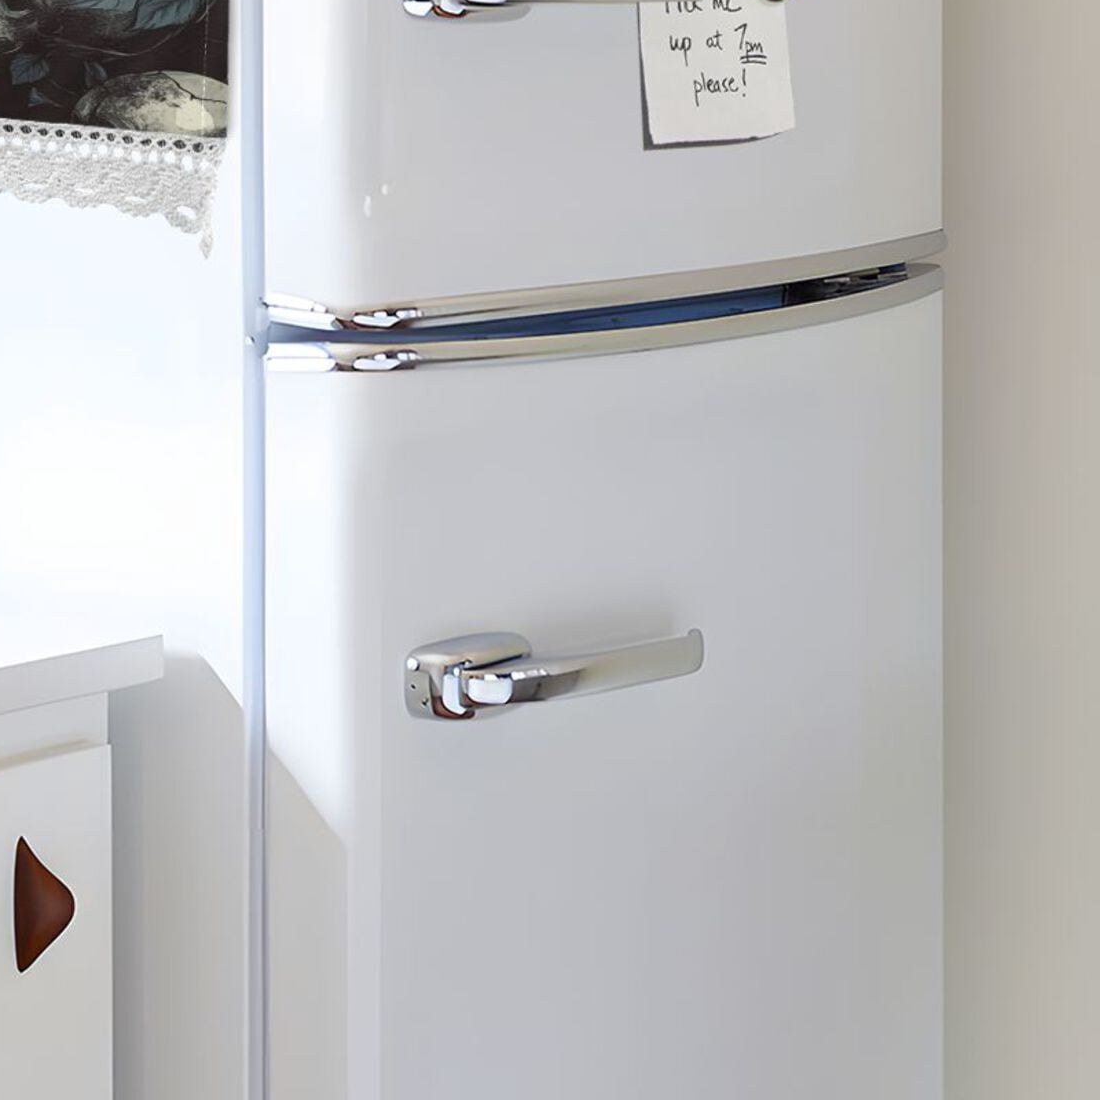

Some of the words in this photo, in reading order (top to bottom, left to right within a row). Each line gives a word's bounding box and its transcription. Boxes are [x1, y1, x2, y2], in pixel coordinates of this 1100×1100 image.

[669, 35, 692, 67] up
[706, 30, 723, 51] at
[693, 68, 747, 107] please!
